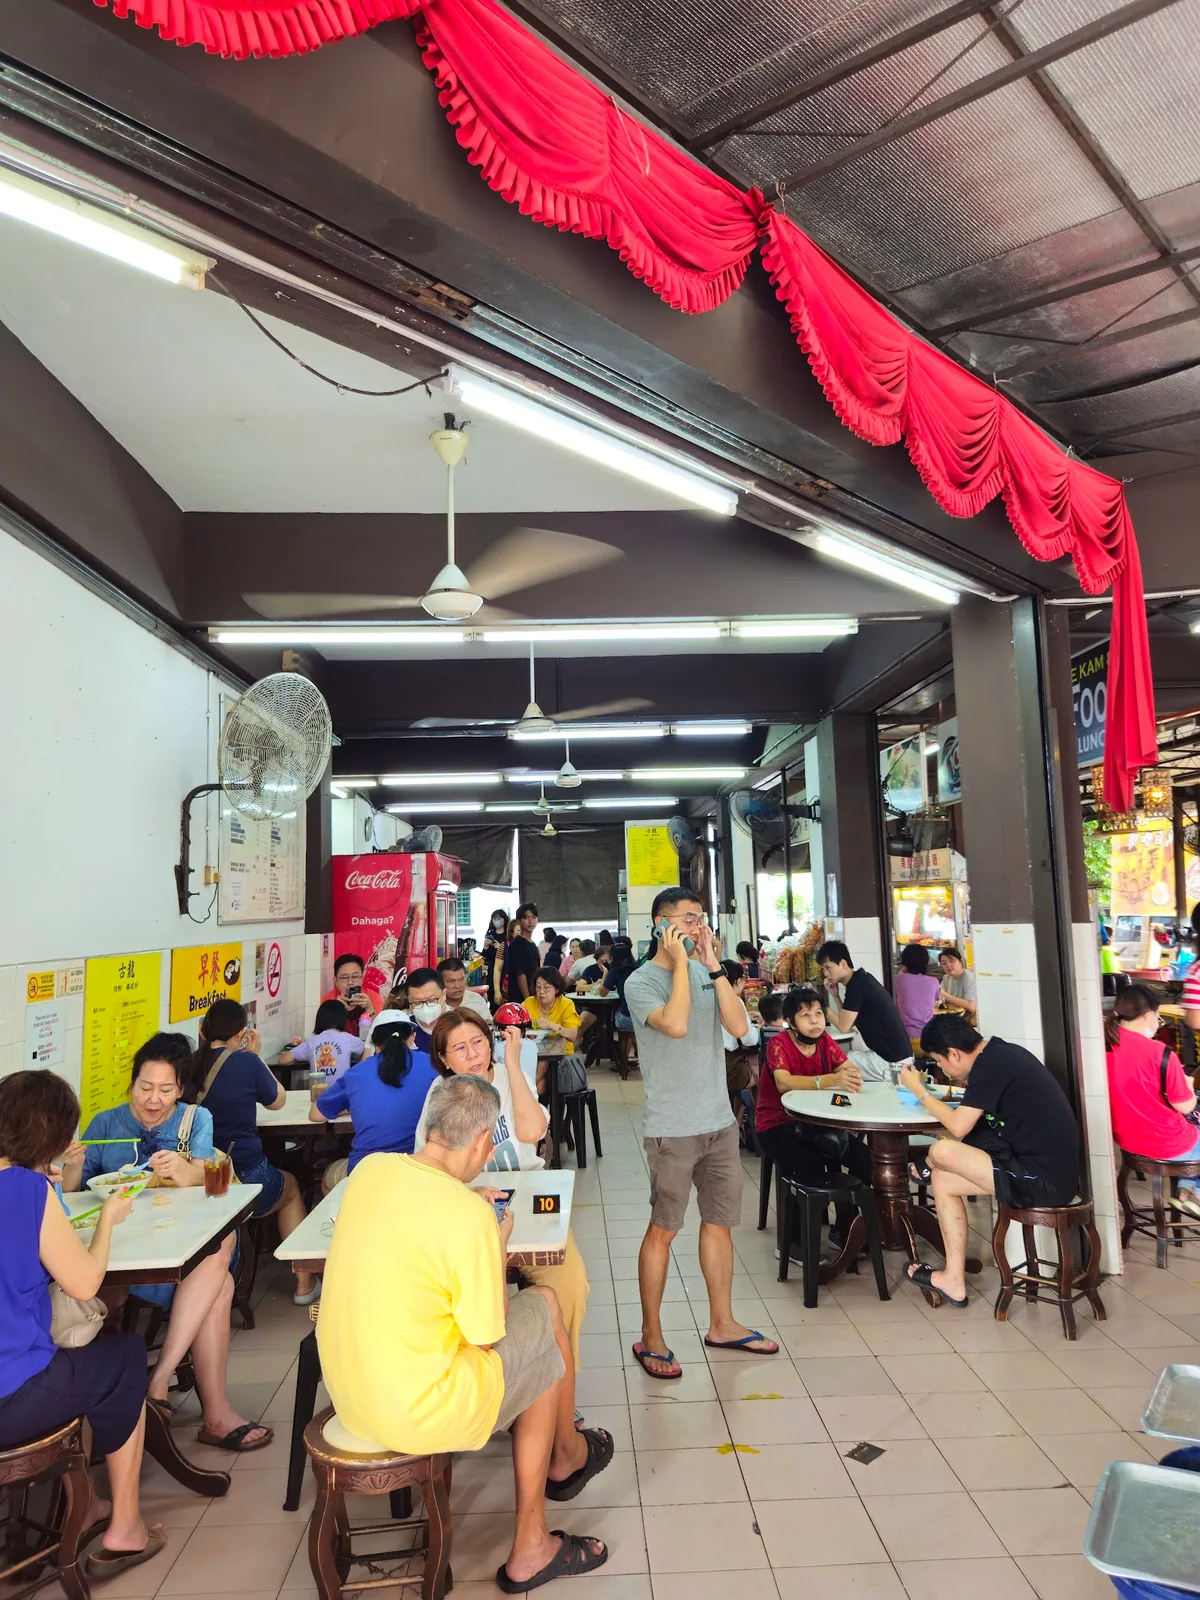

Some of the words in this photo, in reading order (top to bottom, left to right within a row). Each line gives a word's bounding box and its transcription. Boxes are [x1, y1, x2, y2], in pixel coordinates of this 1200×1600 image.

[1079, 655, 1104, 679] KAM
[345, 869, 403, 890] Coca-Cola
[351, 915, 394, 926] Dahaga?
[198, 950, 221, 987] 早餐
[835, 1095, 842, 1105] 8
[539, 1197, 554, 1211] 10
